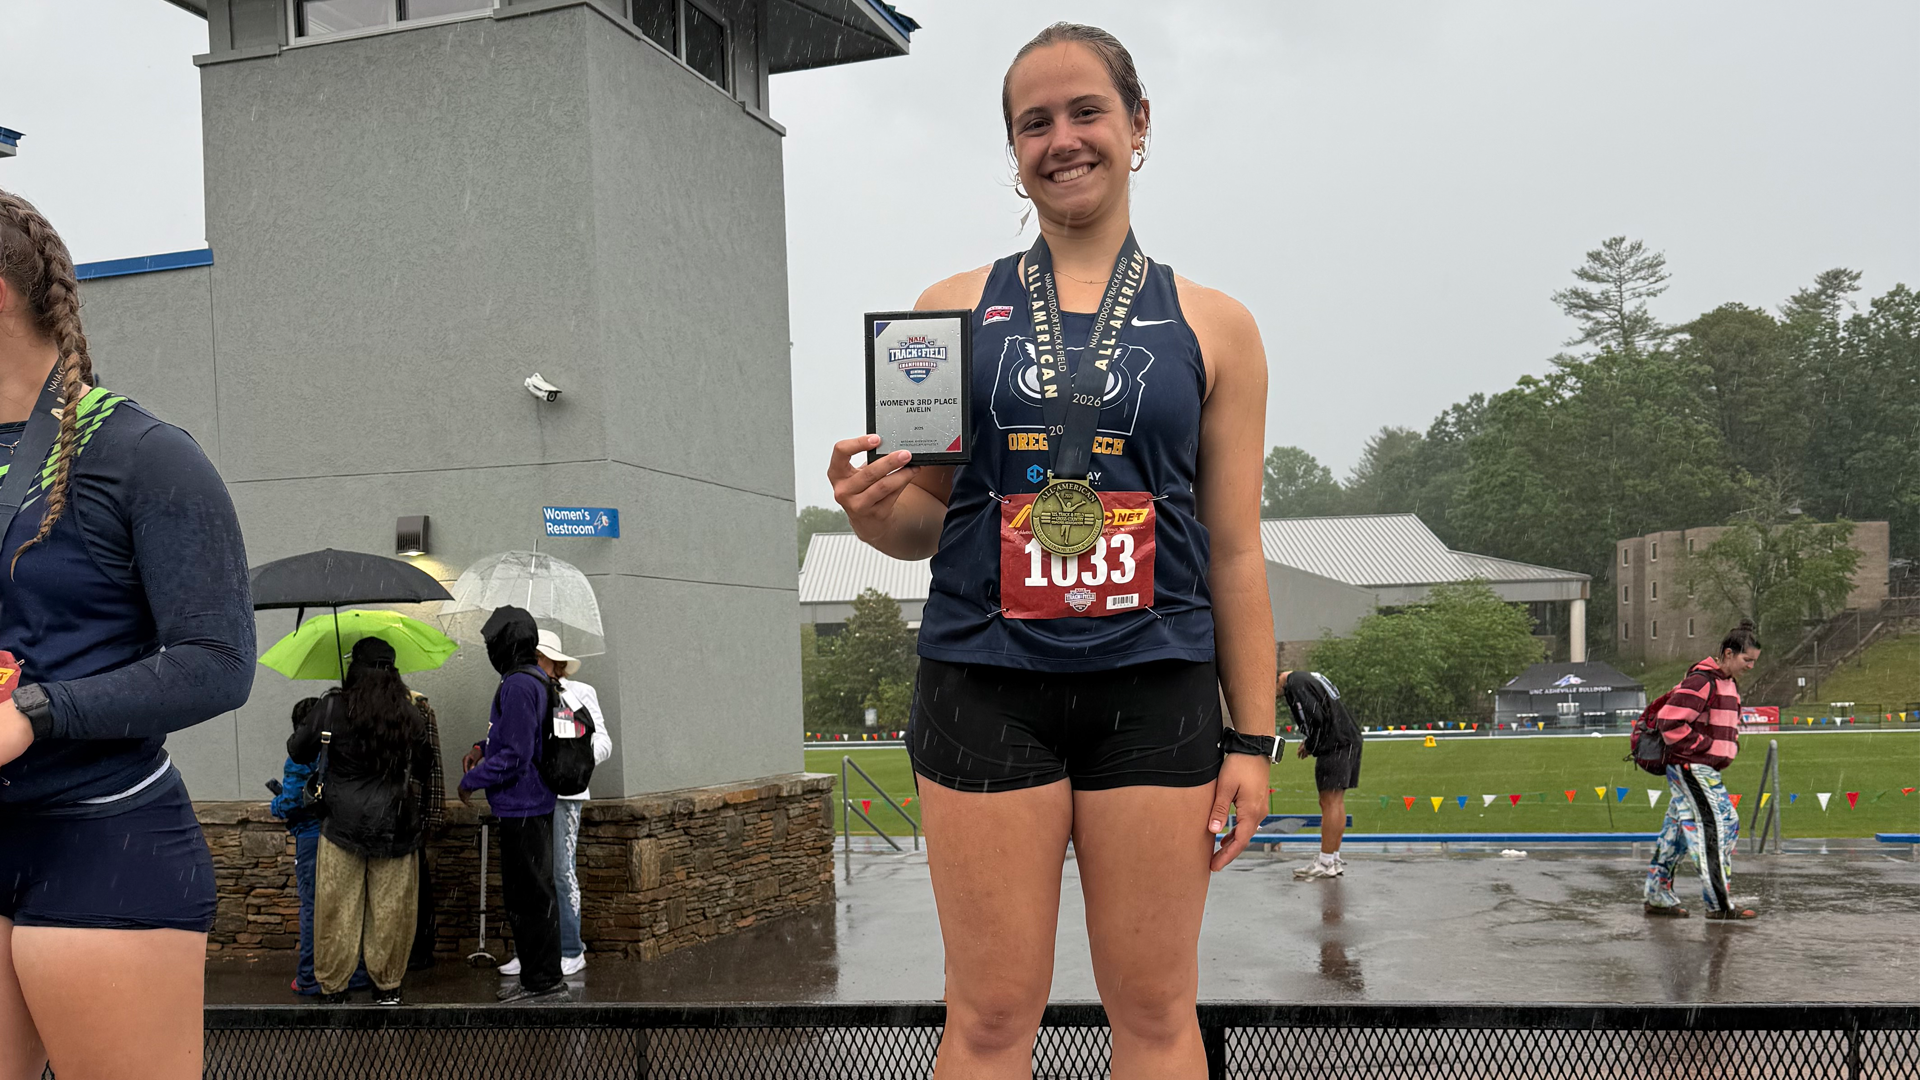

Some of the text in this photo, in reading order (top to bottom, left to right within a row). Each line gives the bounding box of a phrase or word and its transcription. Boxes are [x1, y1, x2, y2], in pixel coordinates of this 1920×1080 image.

[1044, 272, 1053, 290] NAIA
[1047, 289, 1060, 324] OUTDOOR
[1088, 332, 1102, 348] NAIA
[1095, 297, 1114, 332] OUTDOOR
[1107, 277, 1122, 298] TRACK
[1117, 257, 1128, 275] FIELD
[1052, 323, 1063, 345] TRACK
[889, 348, 918, 361] TRACK
[921, 347, 946, 359] FIELD
[1057, 350, 1067, 372] FIELD
[47, 374, 63, 393] NAIA
[880, 397, 958, 407] WOMEN'S 3RD PLACE
[1072, 392, 1102, 407] 2026
[1048, 424, 1066, 436] 20
[1008, 433, 1125, 456] OREG ECH
[543, 508, 590, 521] Women's
[1116, 512, 1144, 523] NET
[546, 522, 595, 535] Restroom
[1024, 533, 1136, 587] 1033
[1544, 687, 1578, 695] ASHEVILLE
